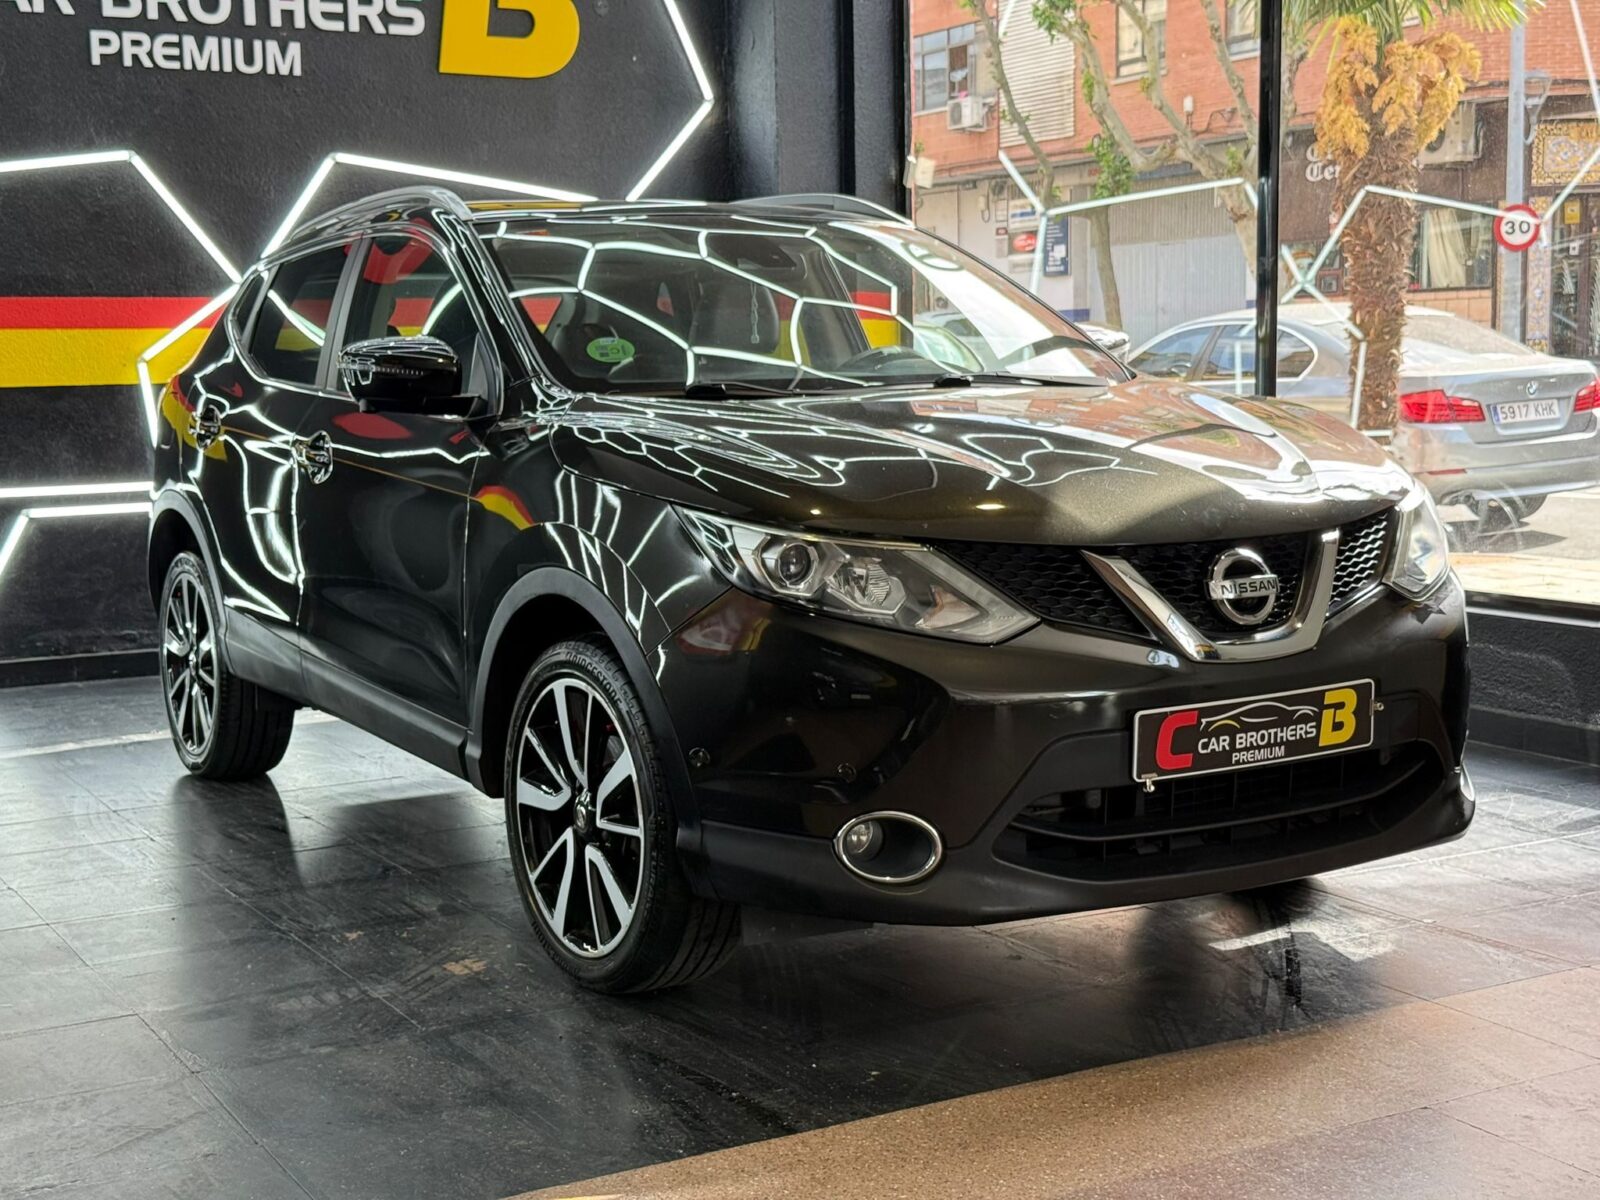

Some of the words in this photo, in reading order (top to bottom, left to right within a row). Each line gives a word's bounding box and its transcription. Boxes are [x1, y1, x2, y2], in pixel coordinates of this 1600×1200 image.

[89, 29, 302, 77] PREMIUM
[1505, 220, 1530, 235] 30
[1500, 404, 1529, 420] 5917
[1533, 401, 1556, 417] KHK
[1221, 578, 1277, 595] NISSAN
[1155, 710, 1199, 770] C
[1198, 735, 1230, 754] CAR
[1235, 721, 1317, 749] BROTHERS
[1231, 746, 1285, 765] PREMIUM
